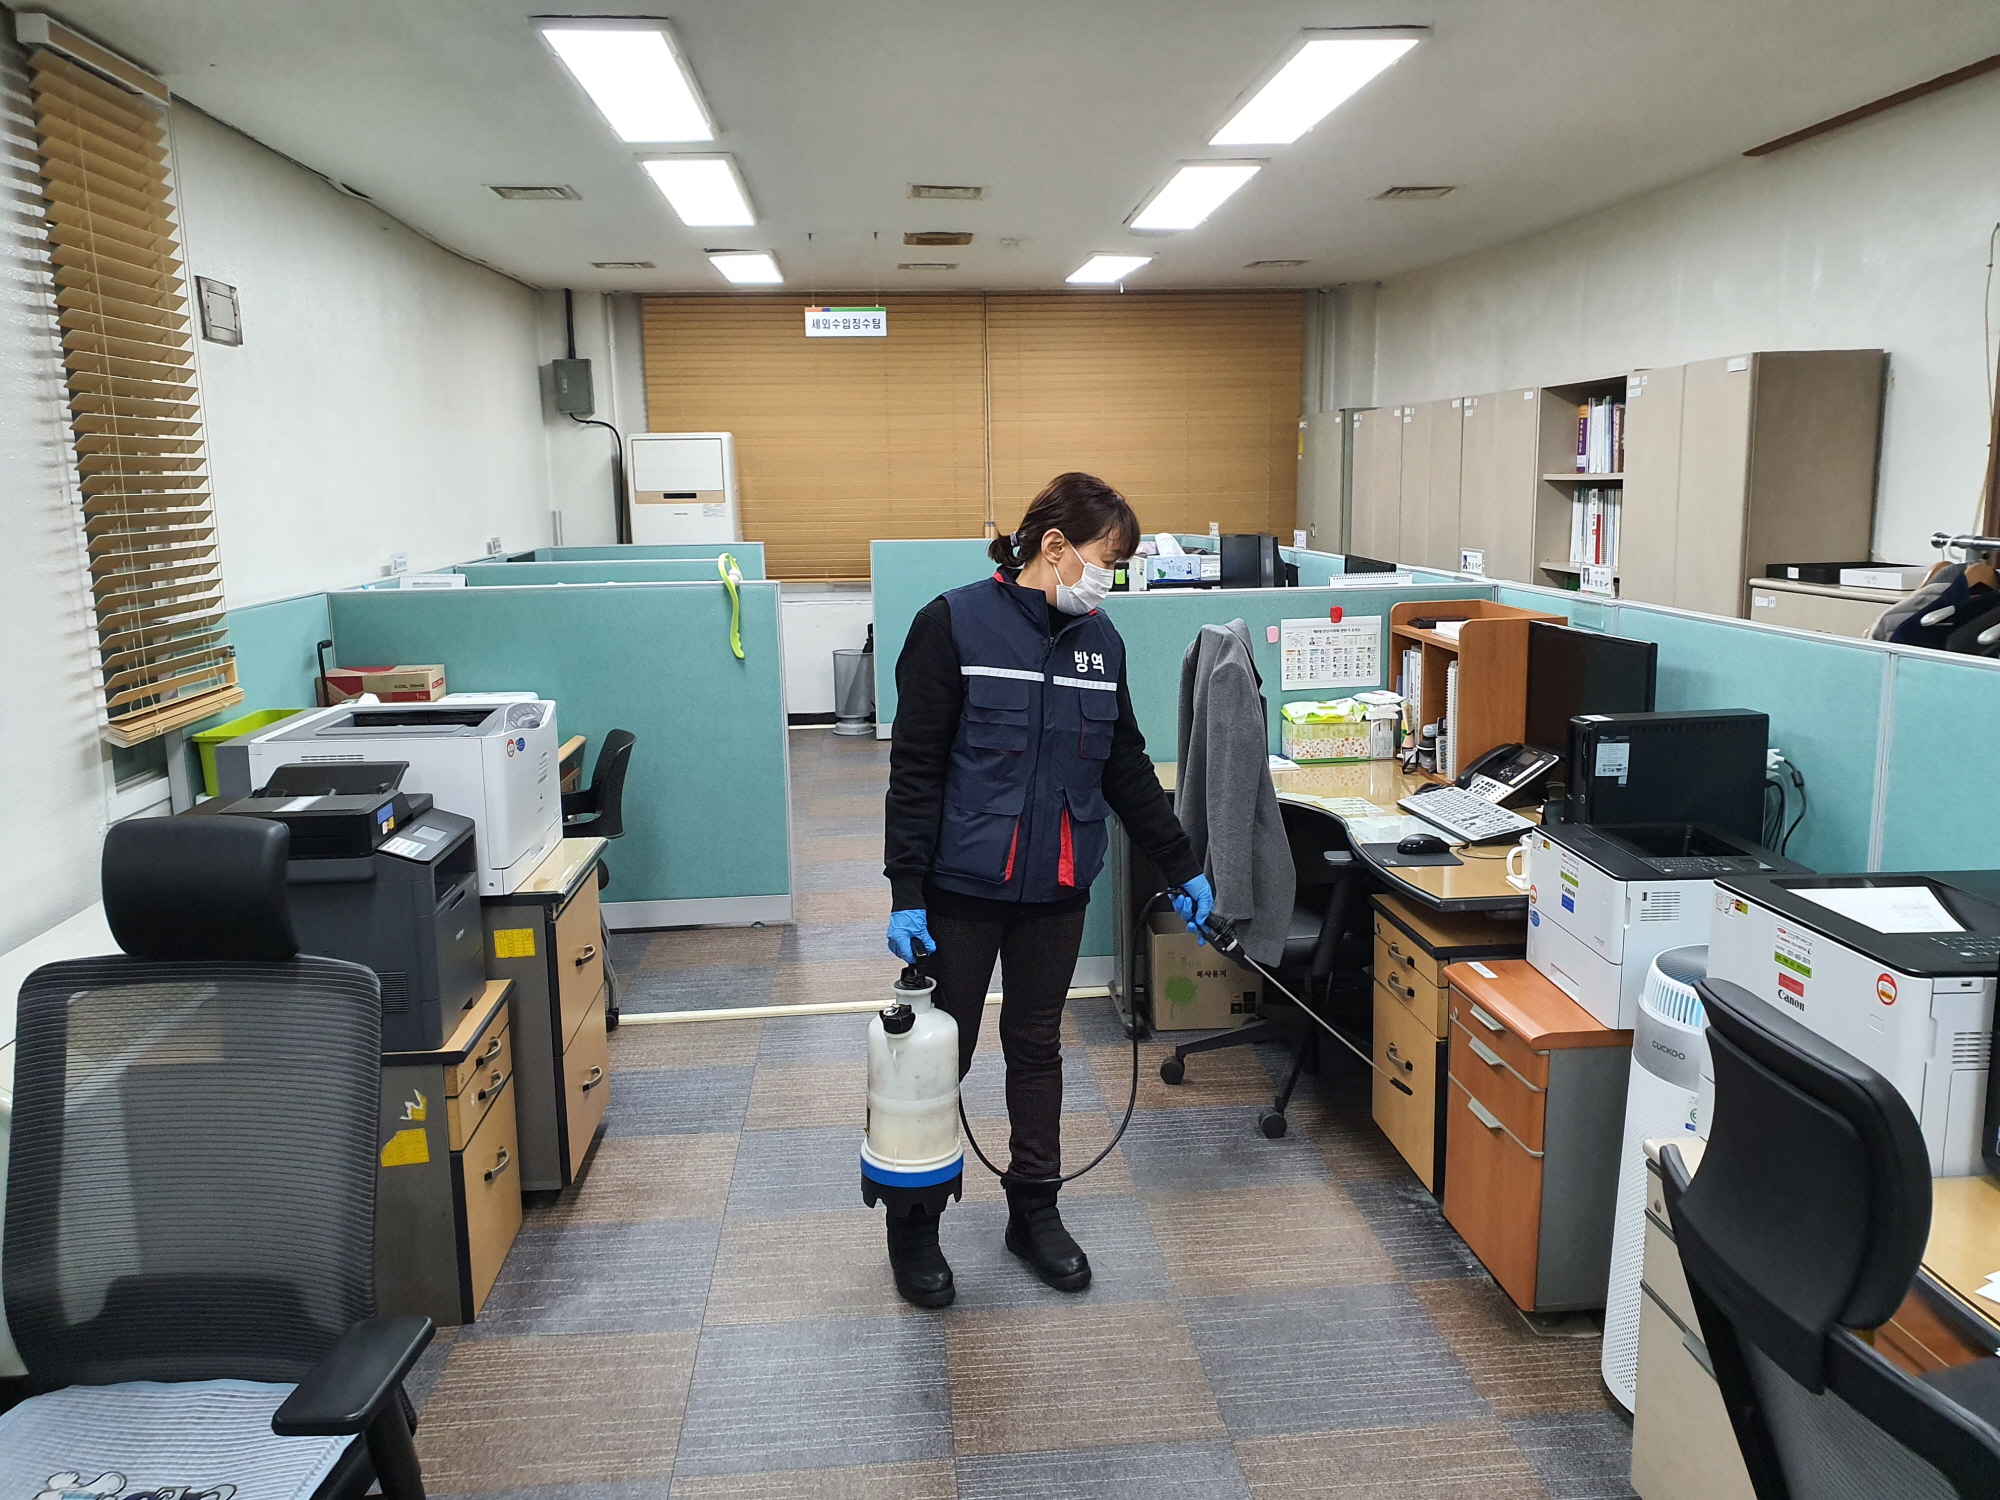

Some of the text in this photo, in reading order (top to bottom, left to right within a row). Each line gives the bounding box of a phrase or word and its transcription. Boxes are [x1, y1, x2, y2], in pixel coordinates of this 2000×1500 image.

[811, 318, 881, 330] 세외수입징수팀
[1074, 650, 1105, 675] 방역
[1561, 883, 1576, 898] Canon
[1196, 969, 1227, 979] 복사용지
[1777, 989, 1805, 1012] Canon
[1651, 1040, 1686, 1060] CUCKOO
